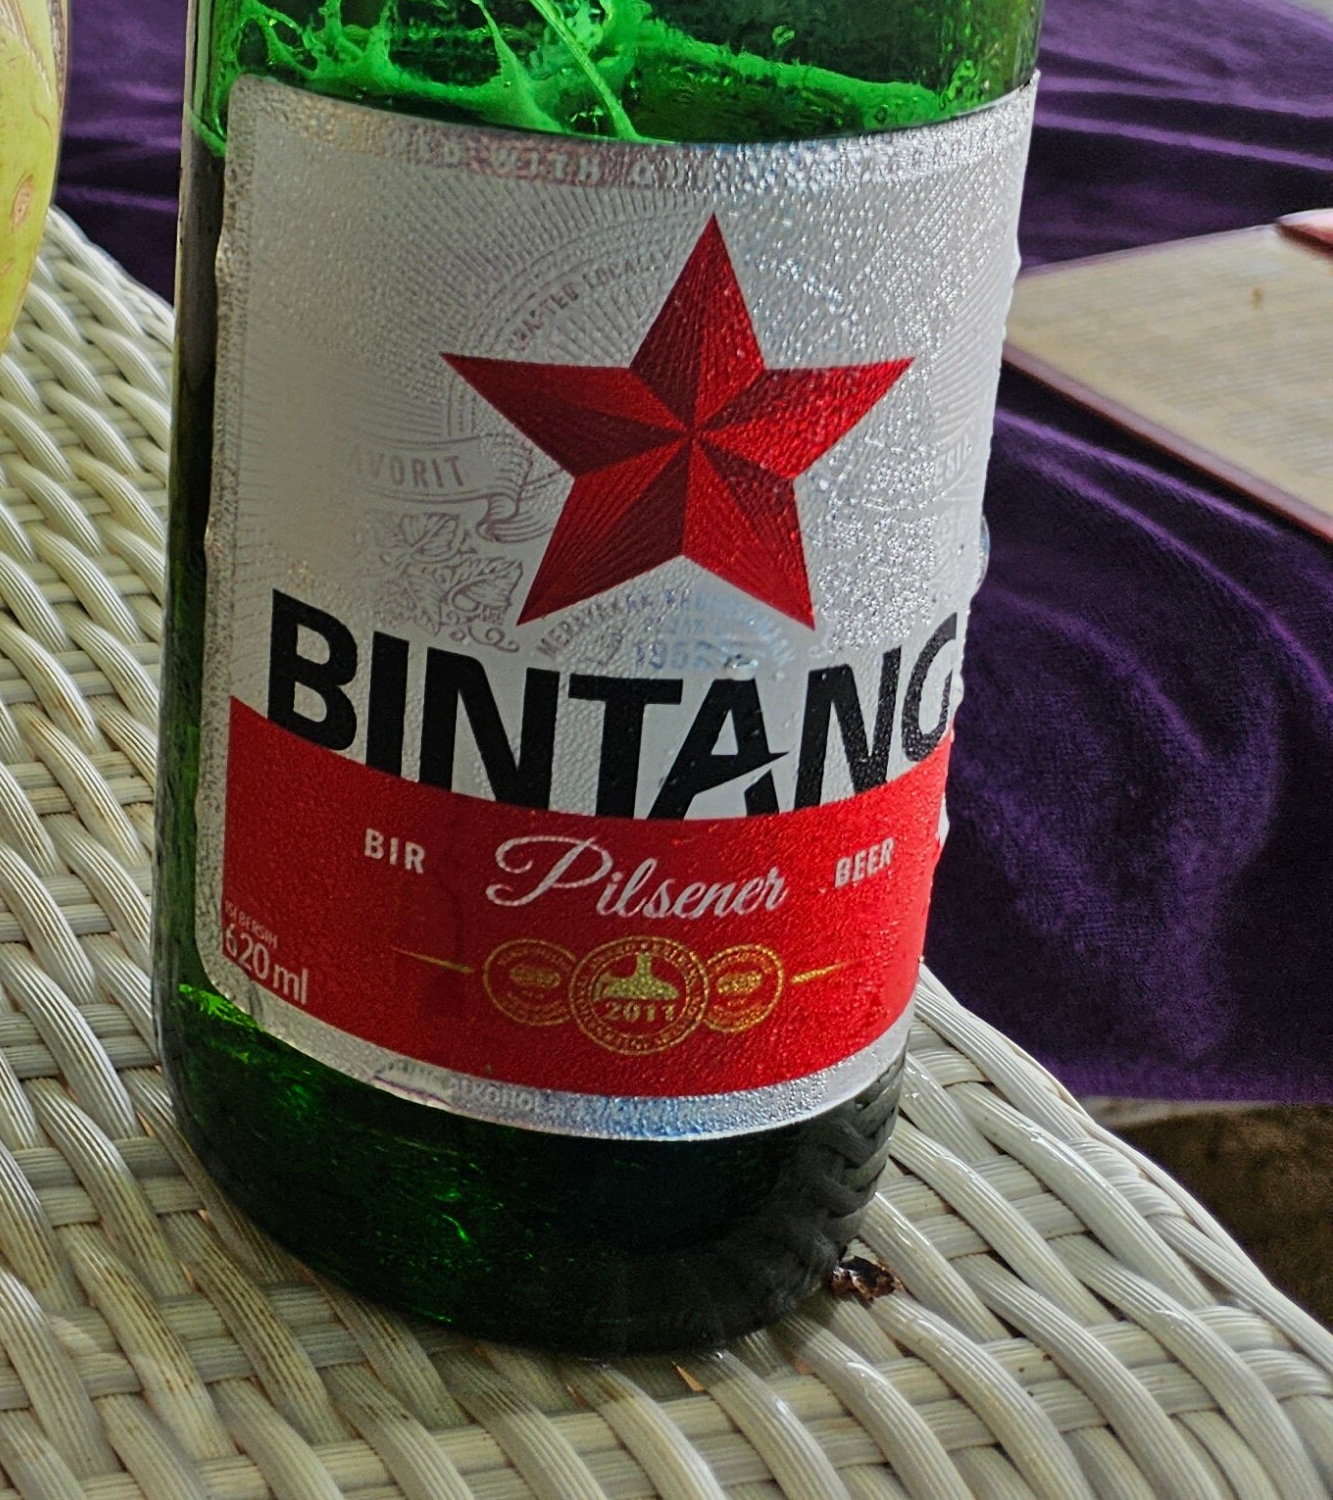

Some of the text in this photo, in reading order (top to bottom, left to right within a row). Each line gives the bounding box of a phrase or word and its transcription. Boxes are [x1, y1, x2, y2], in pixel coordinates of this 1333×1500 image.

[268, 588, 957, 821] BINTANG
[363, 827, 895, 920] BIR Pilsener BEER
